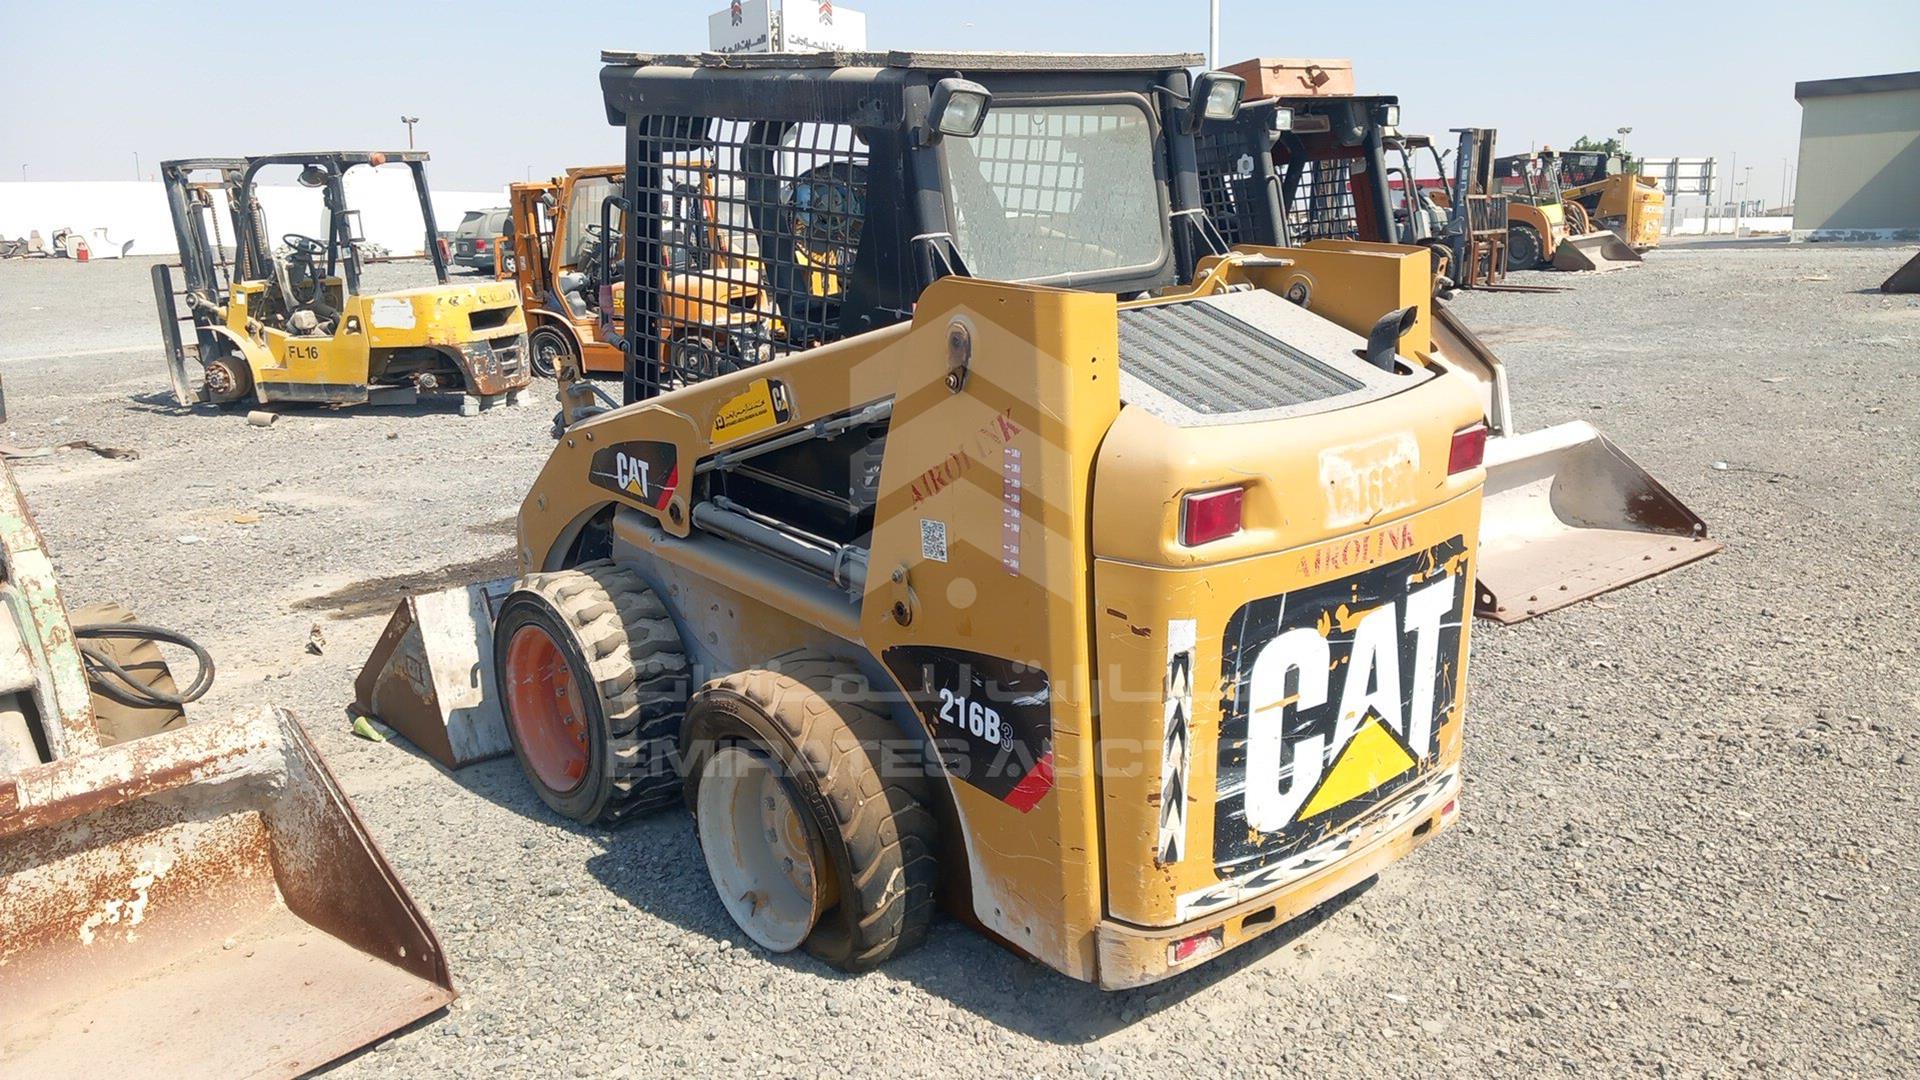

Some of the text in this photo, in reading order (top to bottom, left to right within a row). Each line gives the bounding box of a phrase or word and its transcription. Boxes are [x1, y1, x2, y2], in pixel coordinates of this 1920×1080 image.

[288, 345, 319, 360] FL16
[616, 451, 649, 498] CAT
[1243, 573, 1457, 833] CAT
